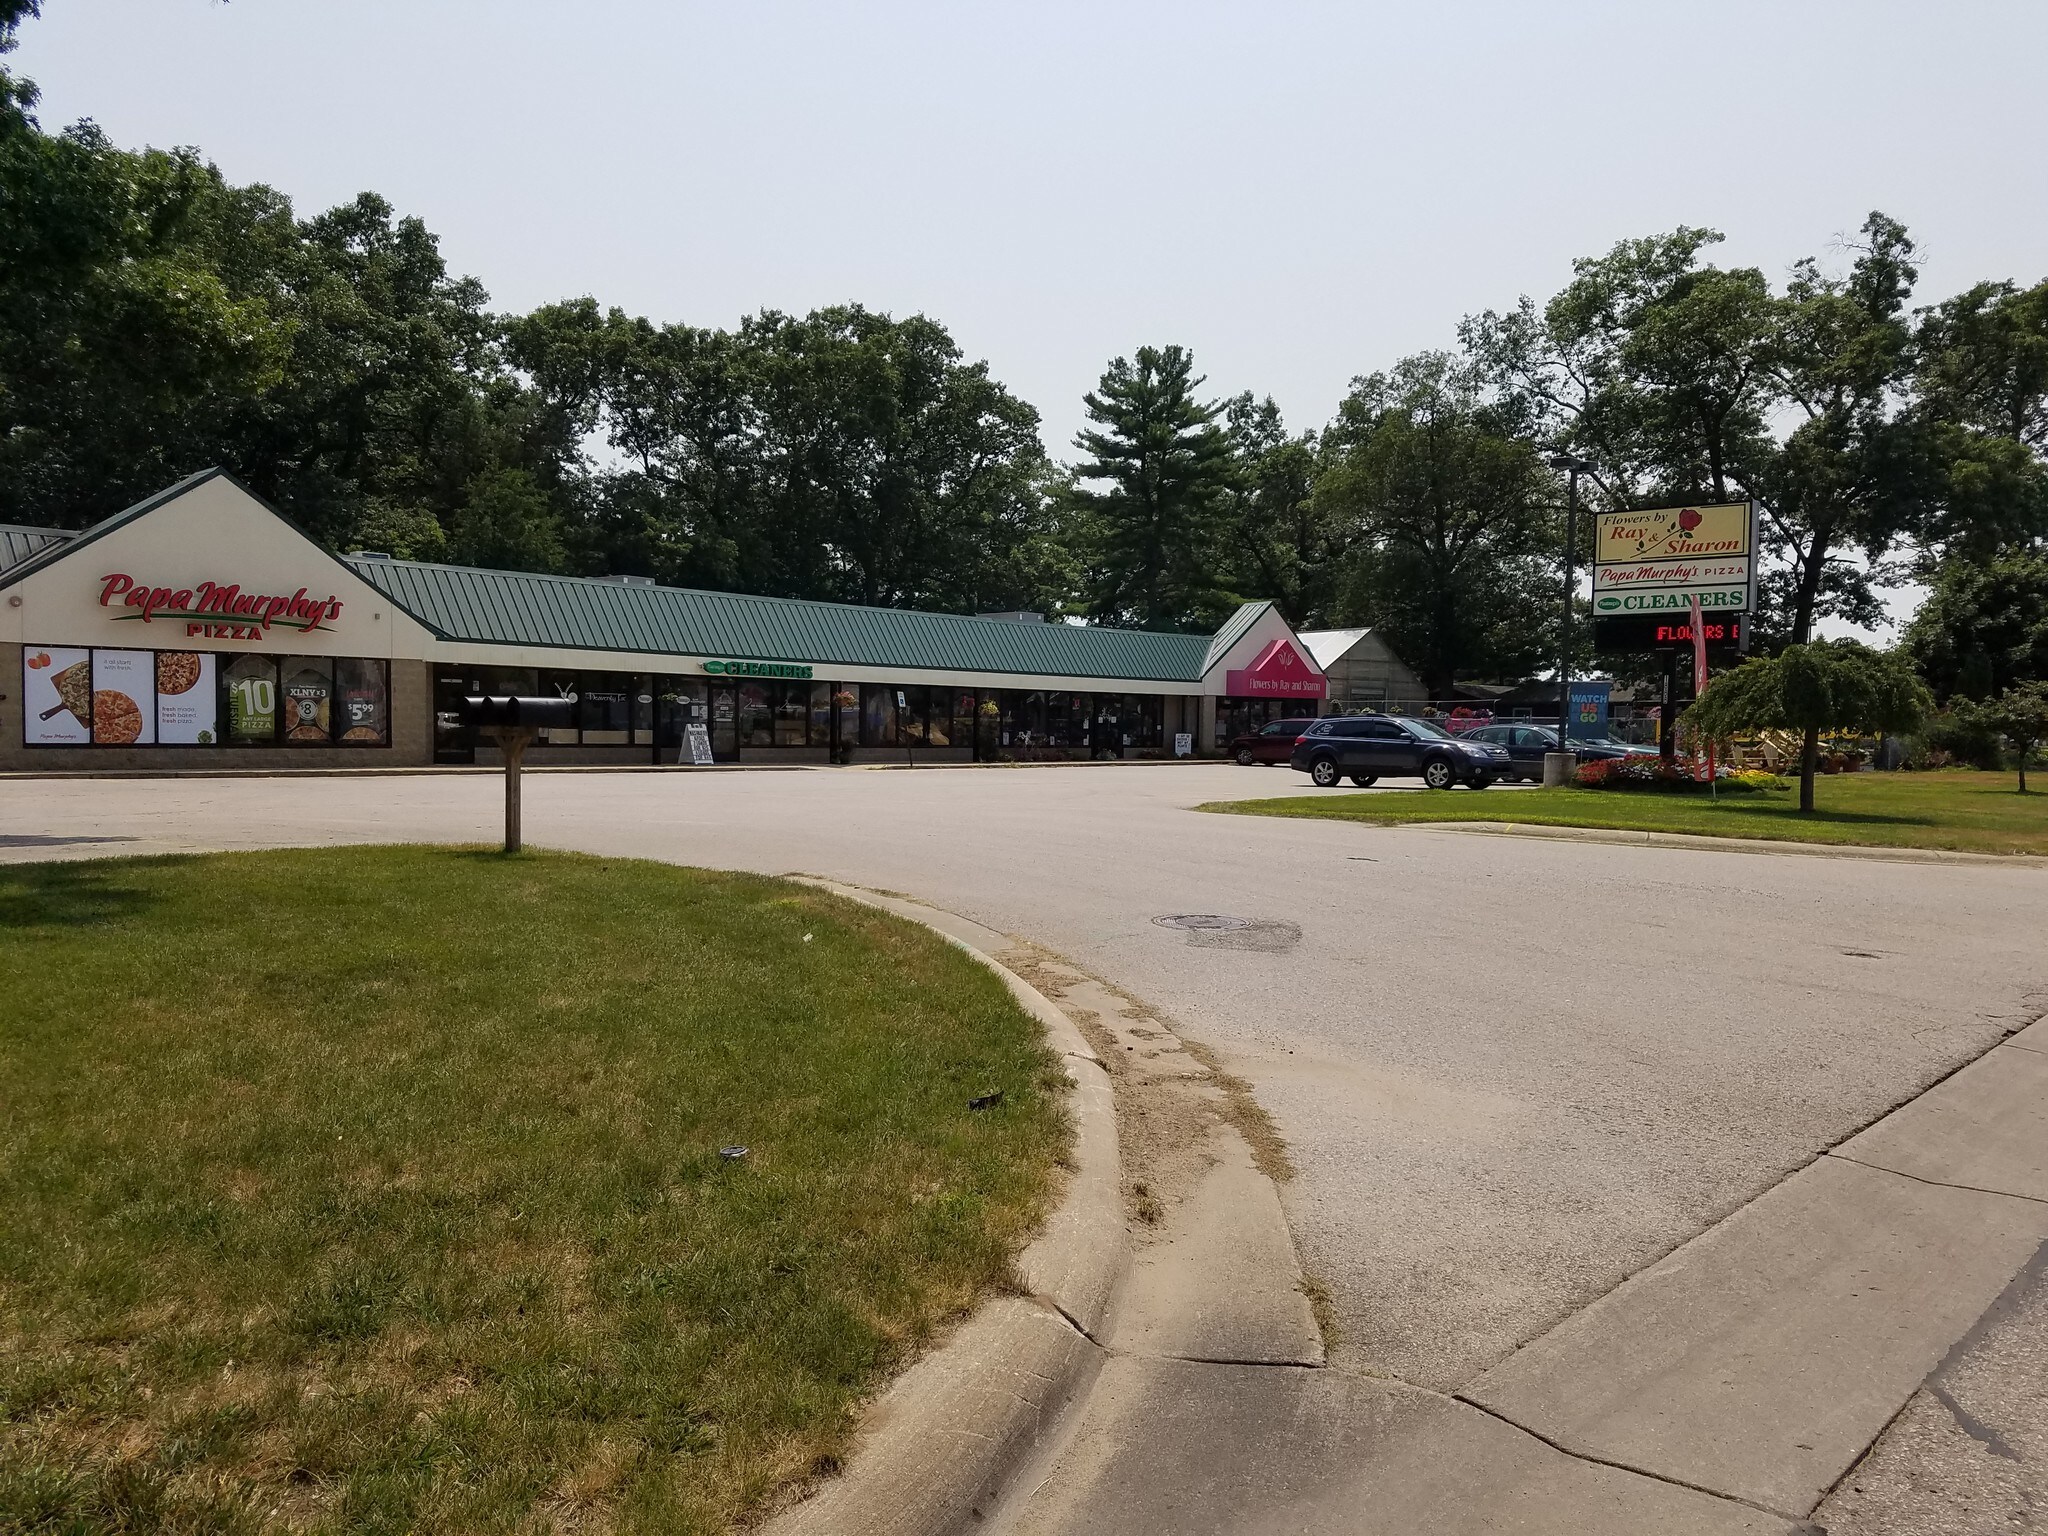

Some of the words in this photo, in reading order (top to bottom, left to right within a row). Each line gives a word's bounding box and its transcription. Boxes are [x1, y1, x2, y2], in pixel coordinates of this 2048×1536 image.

[1603, 514, 1650, 526] Flowers
[1654, 513, 1668, 524] by
[1610, 526, 1648, 542] Ray
[1649, 533, 1660, 543] &
[1664, 539, 1740, 555] Sharon
[1600, 568, 1637, 587] Papa
[1636, 564, 1699, 584] Murphy's
[1705, 567, 1745, 577] PIZZA
[100, 573, 194, 624] Papa
[196, 581, 344, 633] Murphy's
[1623, 591, 1744, 610] CLEANERS
[186, 623, 263, 641] PIZZA
[725, 661, 813, 679] CLEANERS
[1249, 678, 1271, 690] Flowers
[1272, 679, 1279, 691] by
[1280, 679, 1291, 692] Ray
[1292, 681, 1302, 691] and
[1303, 681, 1321, 692] Sharon
[1571, 694, 1608, 703] WATCH
[1581, 703, 1598, 712] US
[242, 721, 273, 729] PIZZA
[1580, 713, 1598, 723] GO
